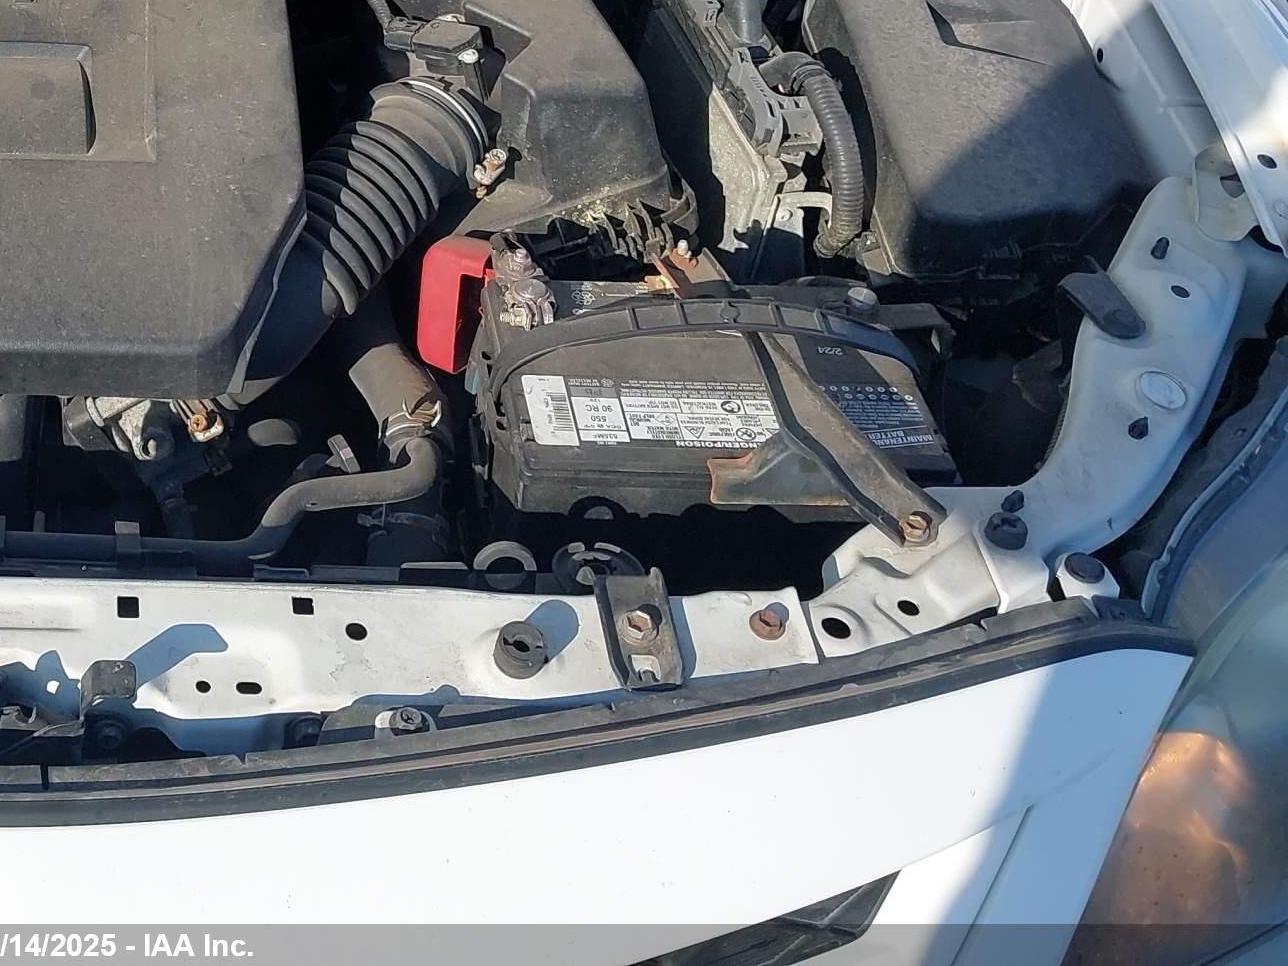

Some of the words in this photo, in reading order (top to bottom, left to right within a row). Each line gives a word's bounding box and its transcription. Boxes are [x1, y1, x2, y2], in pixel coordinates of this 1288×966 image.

[817, 345, 843, 356] 2/24
[585, 404, 600, 412] RC
[601, 405, 614, 413] 90
